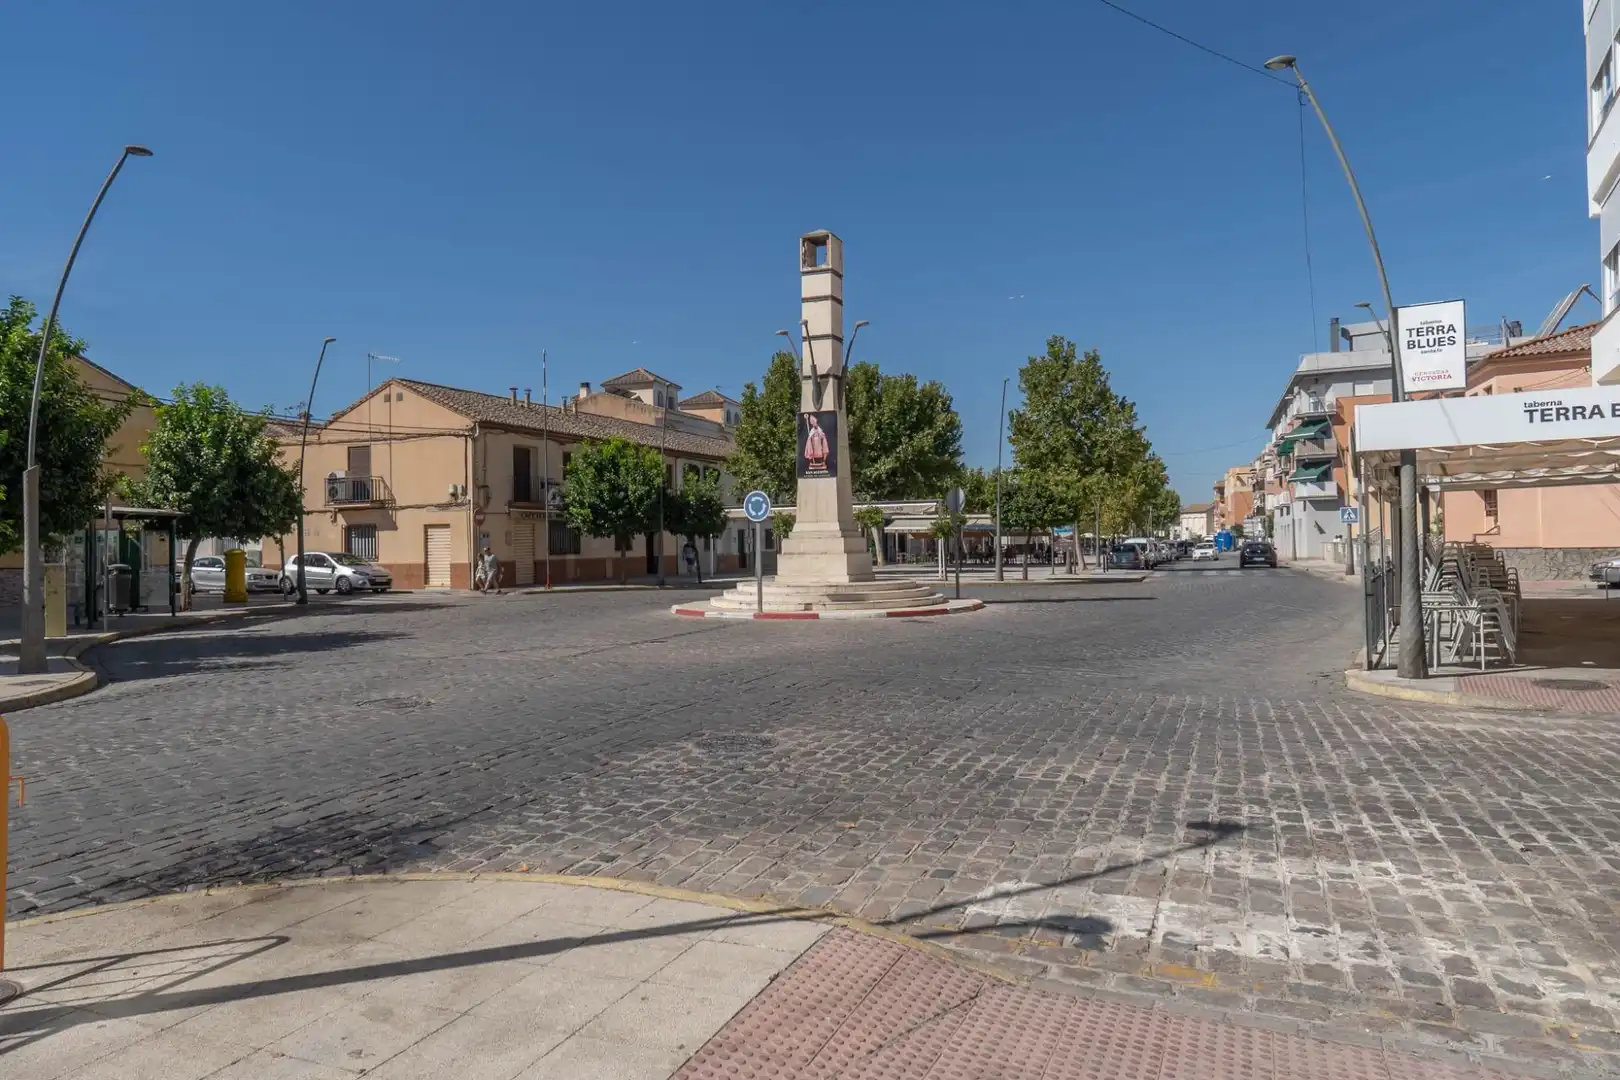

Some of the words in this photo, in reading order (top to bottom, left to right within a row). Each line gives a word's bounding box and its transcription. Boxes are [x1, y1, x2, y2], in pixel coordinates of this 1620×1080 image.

[1405, 323, 1457, 338] TERRA
[1407, 335, 1457, 350] BLUES
[1411, 373, 1453, 382] VICTORIA
[1523, 400, 1563, 408] taberna
[1523, 404, 1606, 424] TERRA
